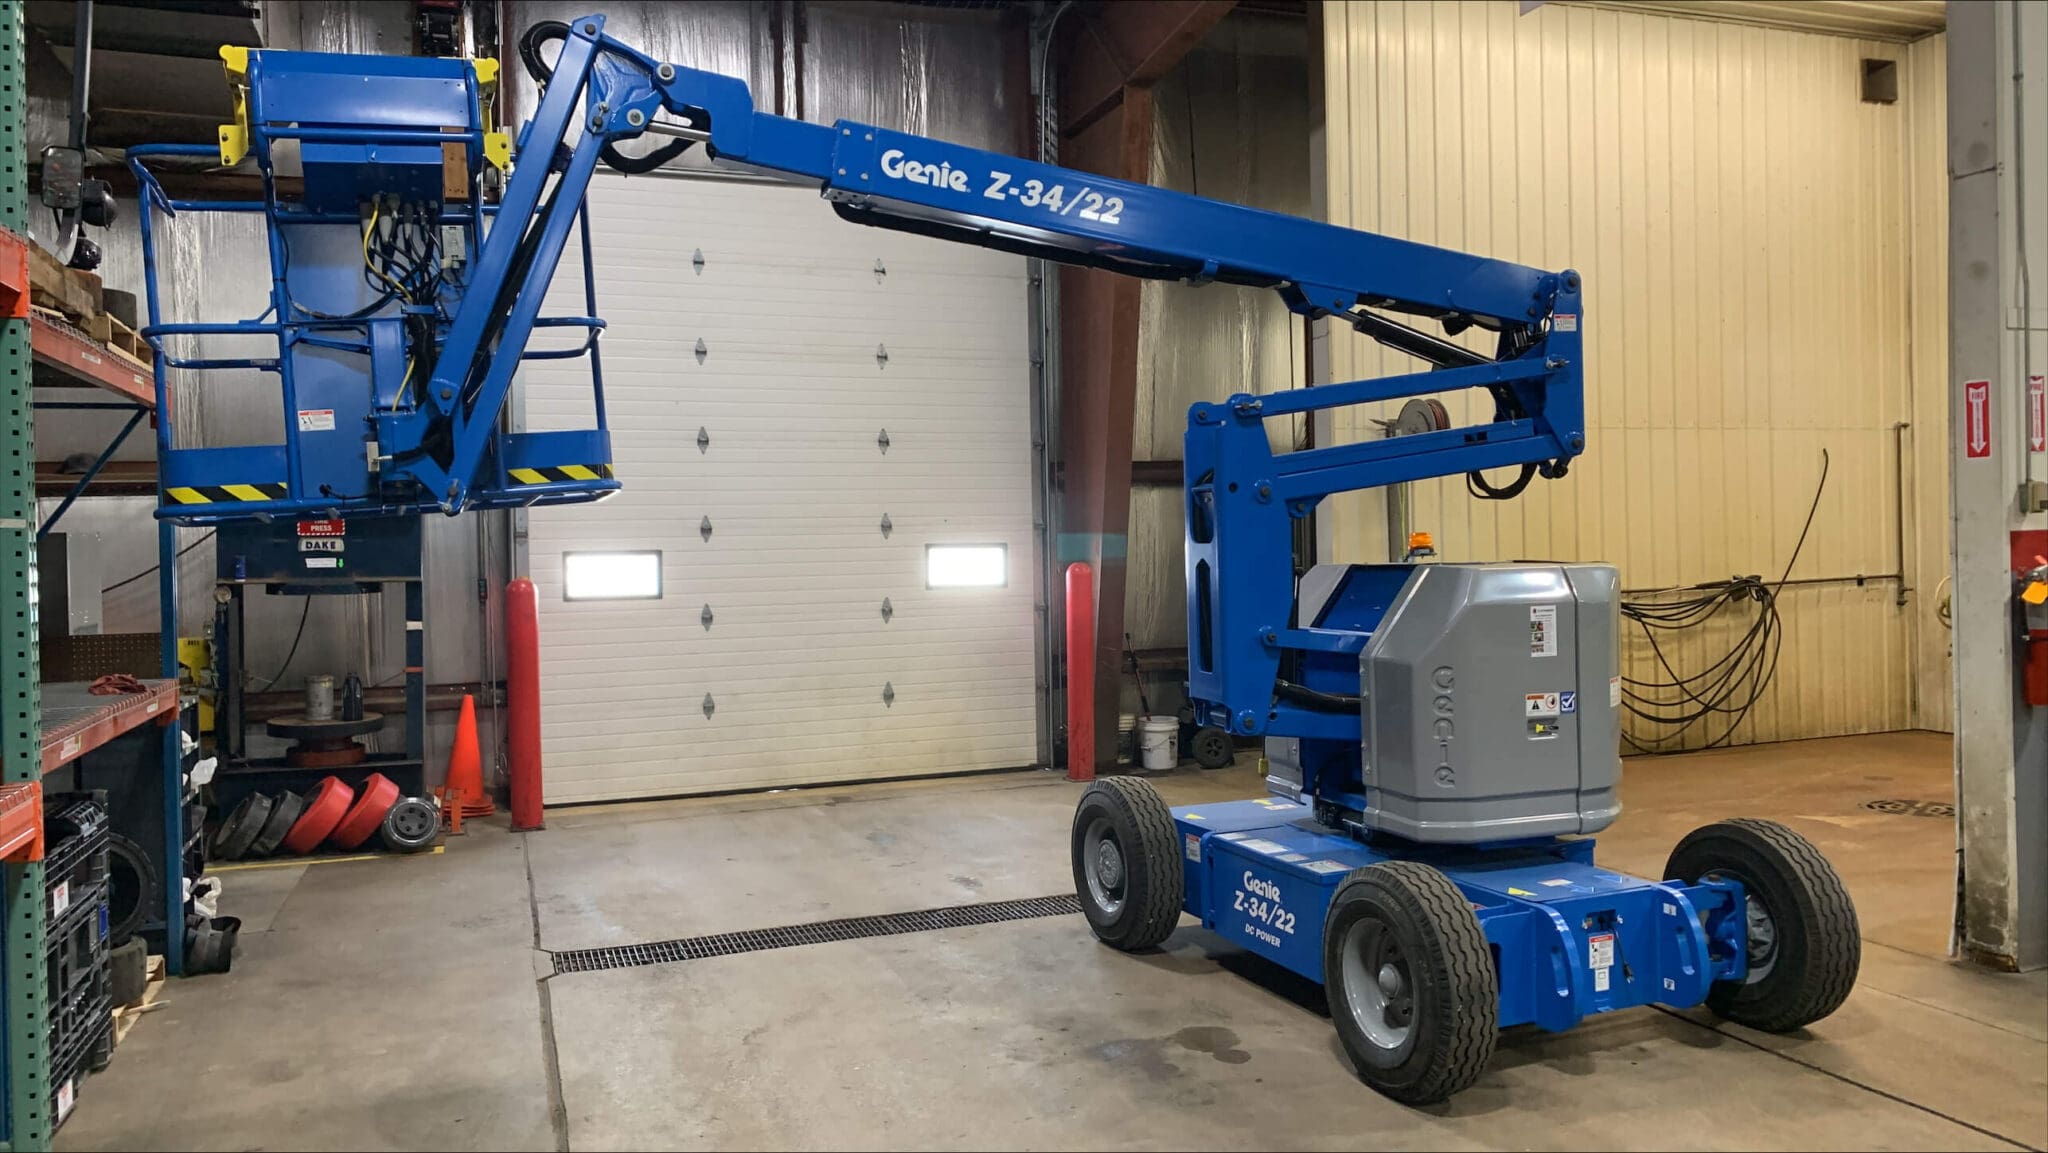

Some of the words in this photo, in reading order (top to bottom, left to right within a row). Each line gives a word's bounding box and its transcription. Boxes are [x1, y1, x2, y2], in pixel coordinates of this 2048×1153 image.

[880, 149, 969, 193] Genie
[984, 170, 1125, 225] Z-34/22
[305, 541, 336, 550] DAKE
[1243, 870, 1281, 903] Genie
[1233, 889, 1296, 935] Z-34/22
[1244, 923, 1255, 935] DC
[1256, 928, 1281, 948] POWER
